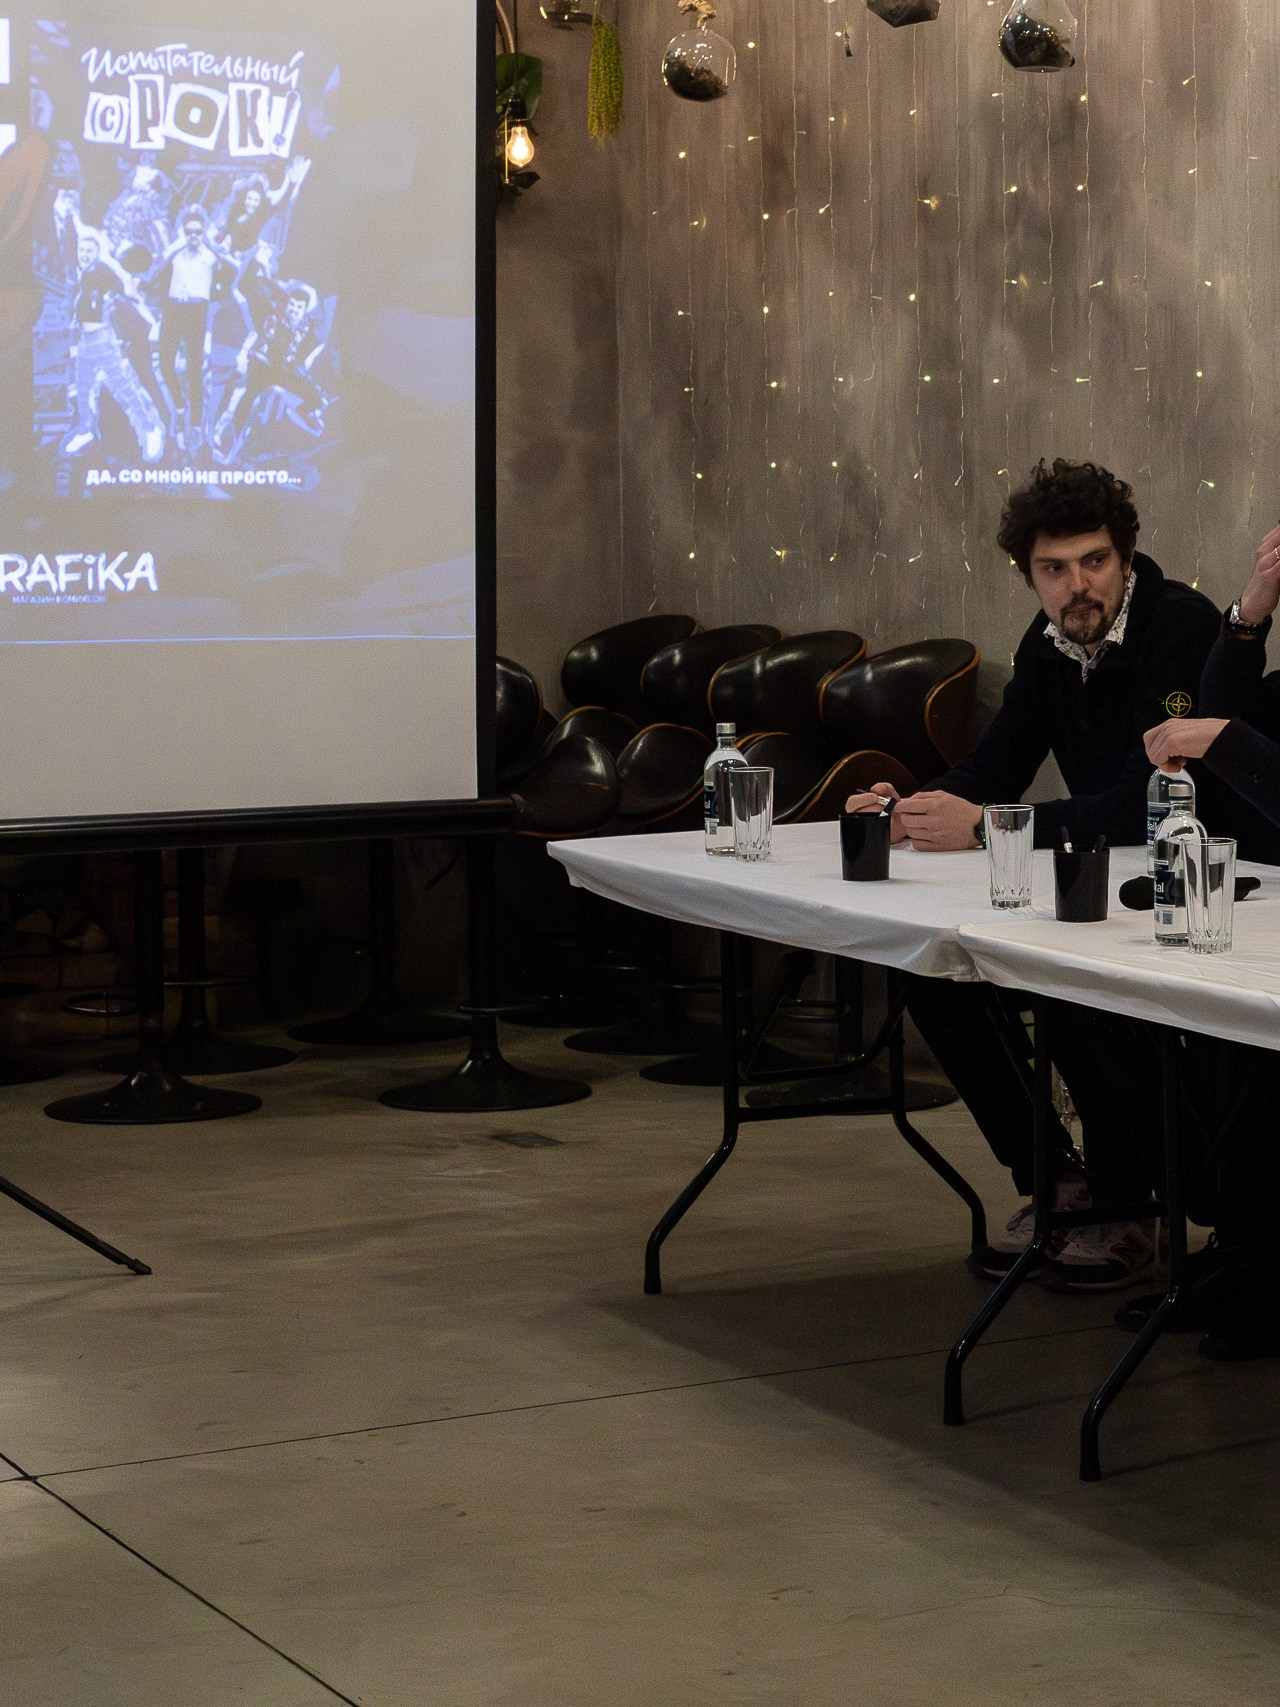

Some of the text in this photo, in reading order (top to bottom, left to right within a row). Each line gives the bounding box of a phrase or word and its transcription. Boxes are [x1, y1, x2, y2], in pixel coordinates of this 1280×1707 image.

[80, 43, 304, 90] Испытательный
[86, 467, 302, 486] ДА, СО МНОЙ НЕ ПРОСТО...
